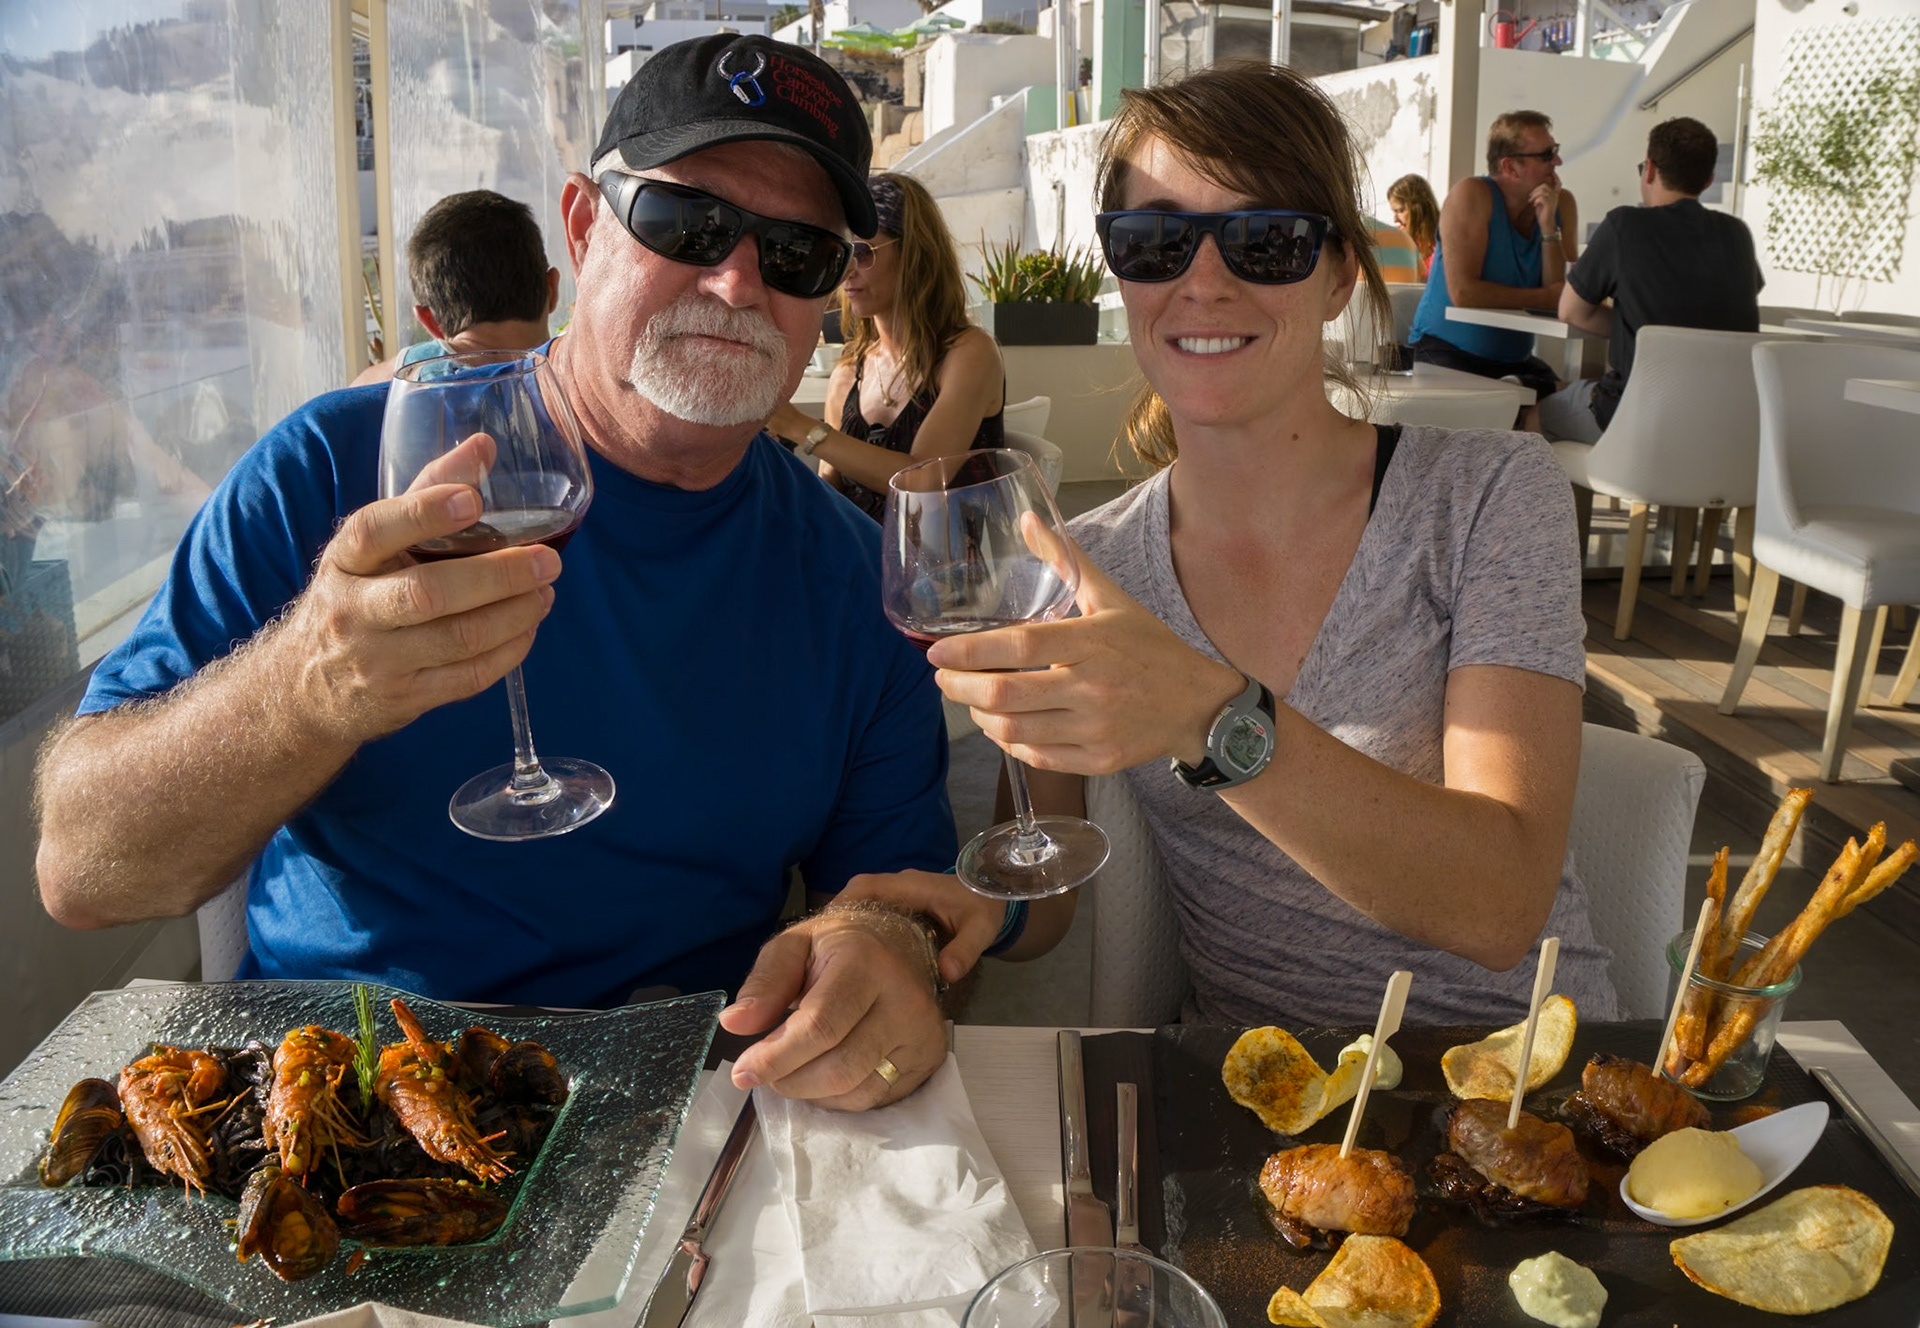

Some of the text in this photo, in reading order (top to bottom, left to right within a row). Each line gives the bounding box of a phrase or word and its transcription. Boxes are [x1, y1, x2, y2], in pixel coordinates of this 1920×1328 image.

[770, 56, 842, 107] Horseshoe
[773, 69, 830, 110] Canyon
[777, 84, 839, 138] Climbing
